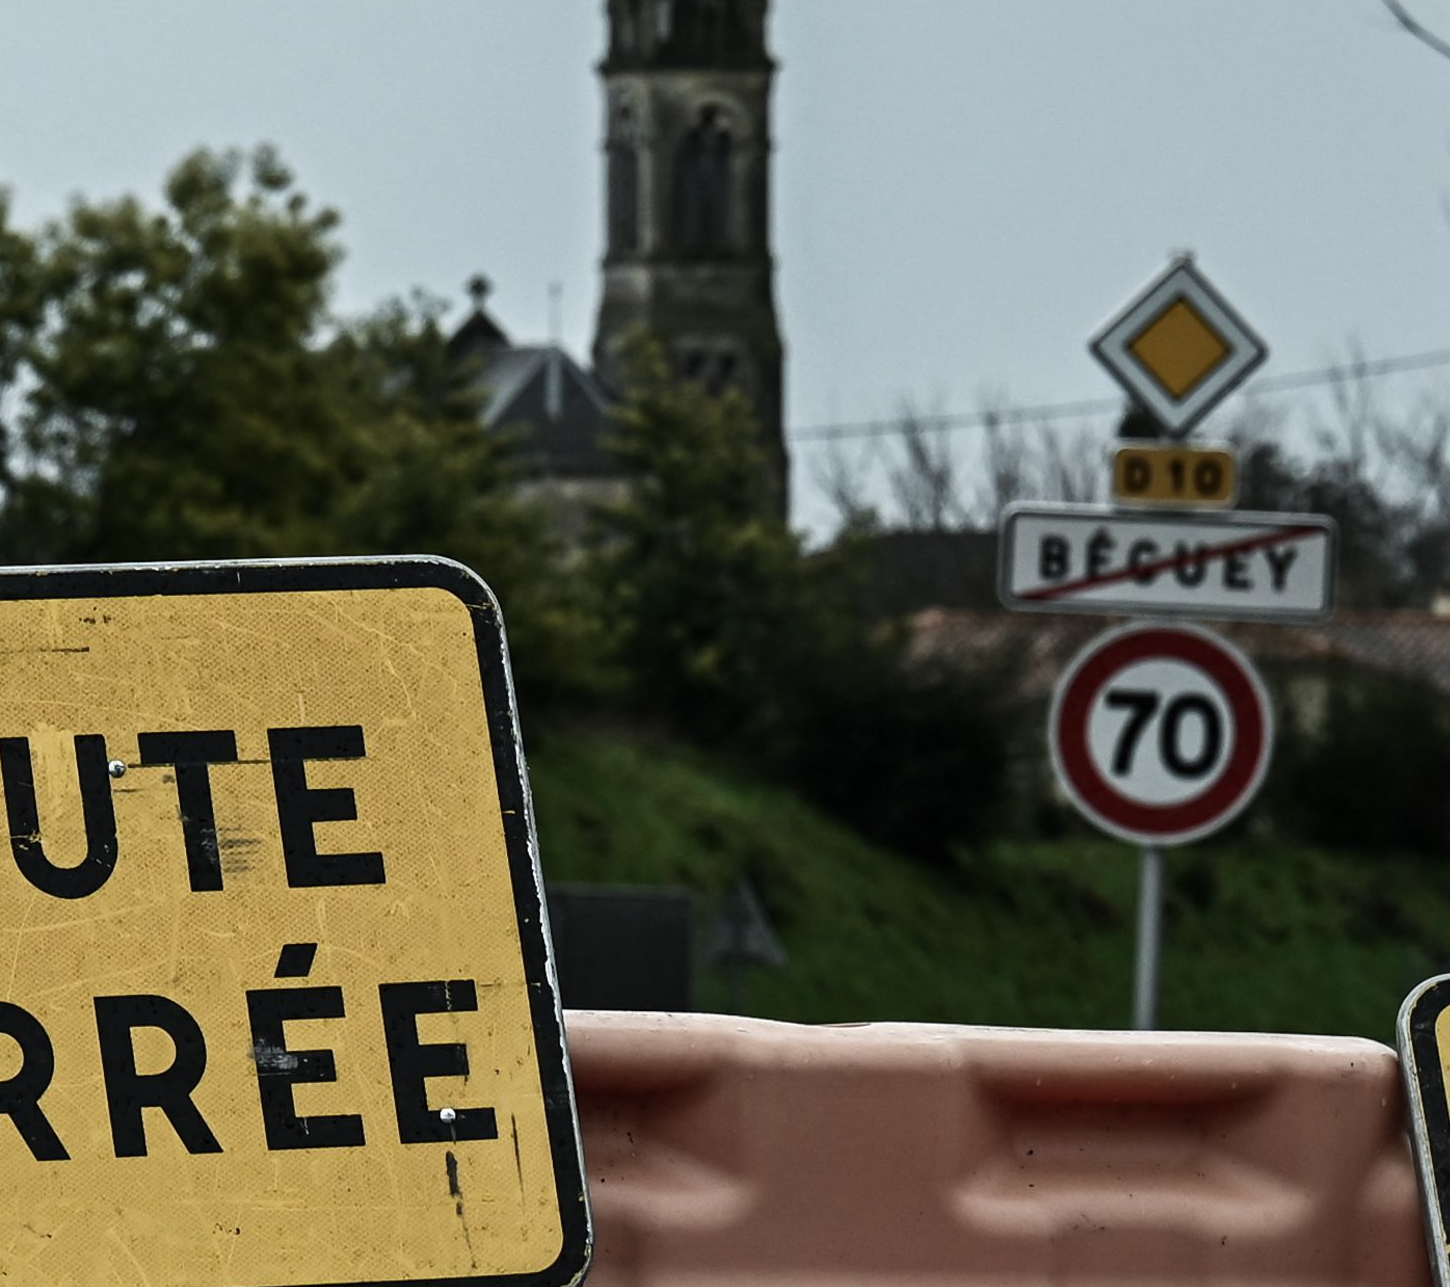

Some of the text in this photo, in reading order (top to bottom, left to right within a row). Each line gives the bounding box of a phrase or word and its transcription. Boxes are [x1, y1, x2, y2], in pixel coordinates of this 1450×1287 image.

[1123, 455, 1225, 498] D 10
[1038, 525, 1297, 593] BÉGUEY
[1103, 689, 1224, 780] 70
